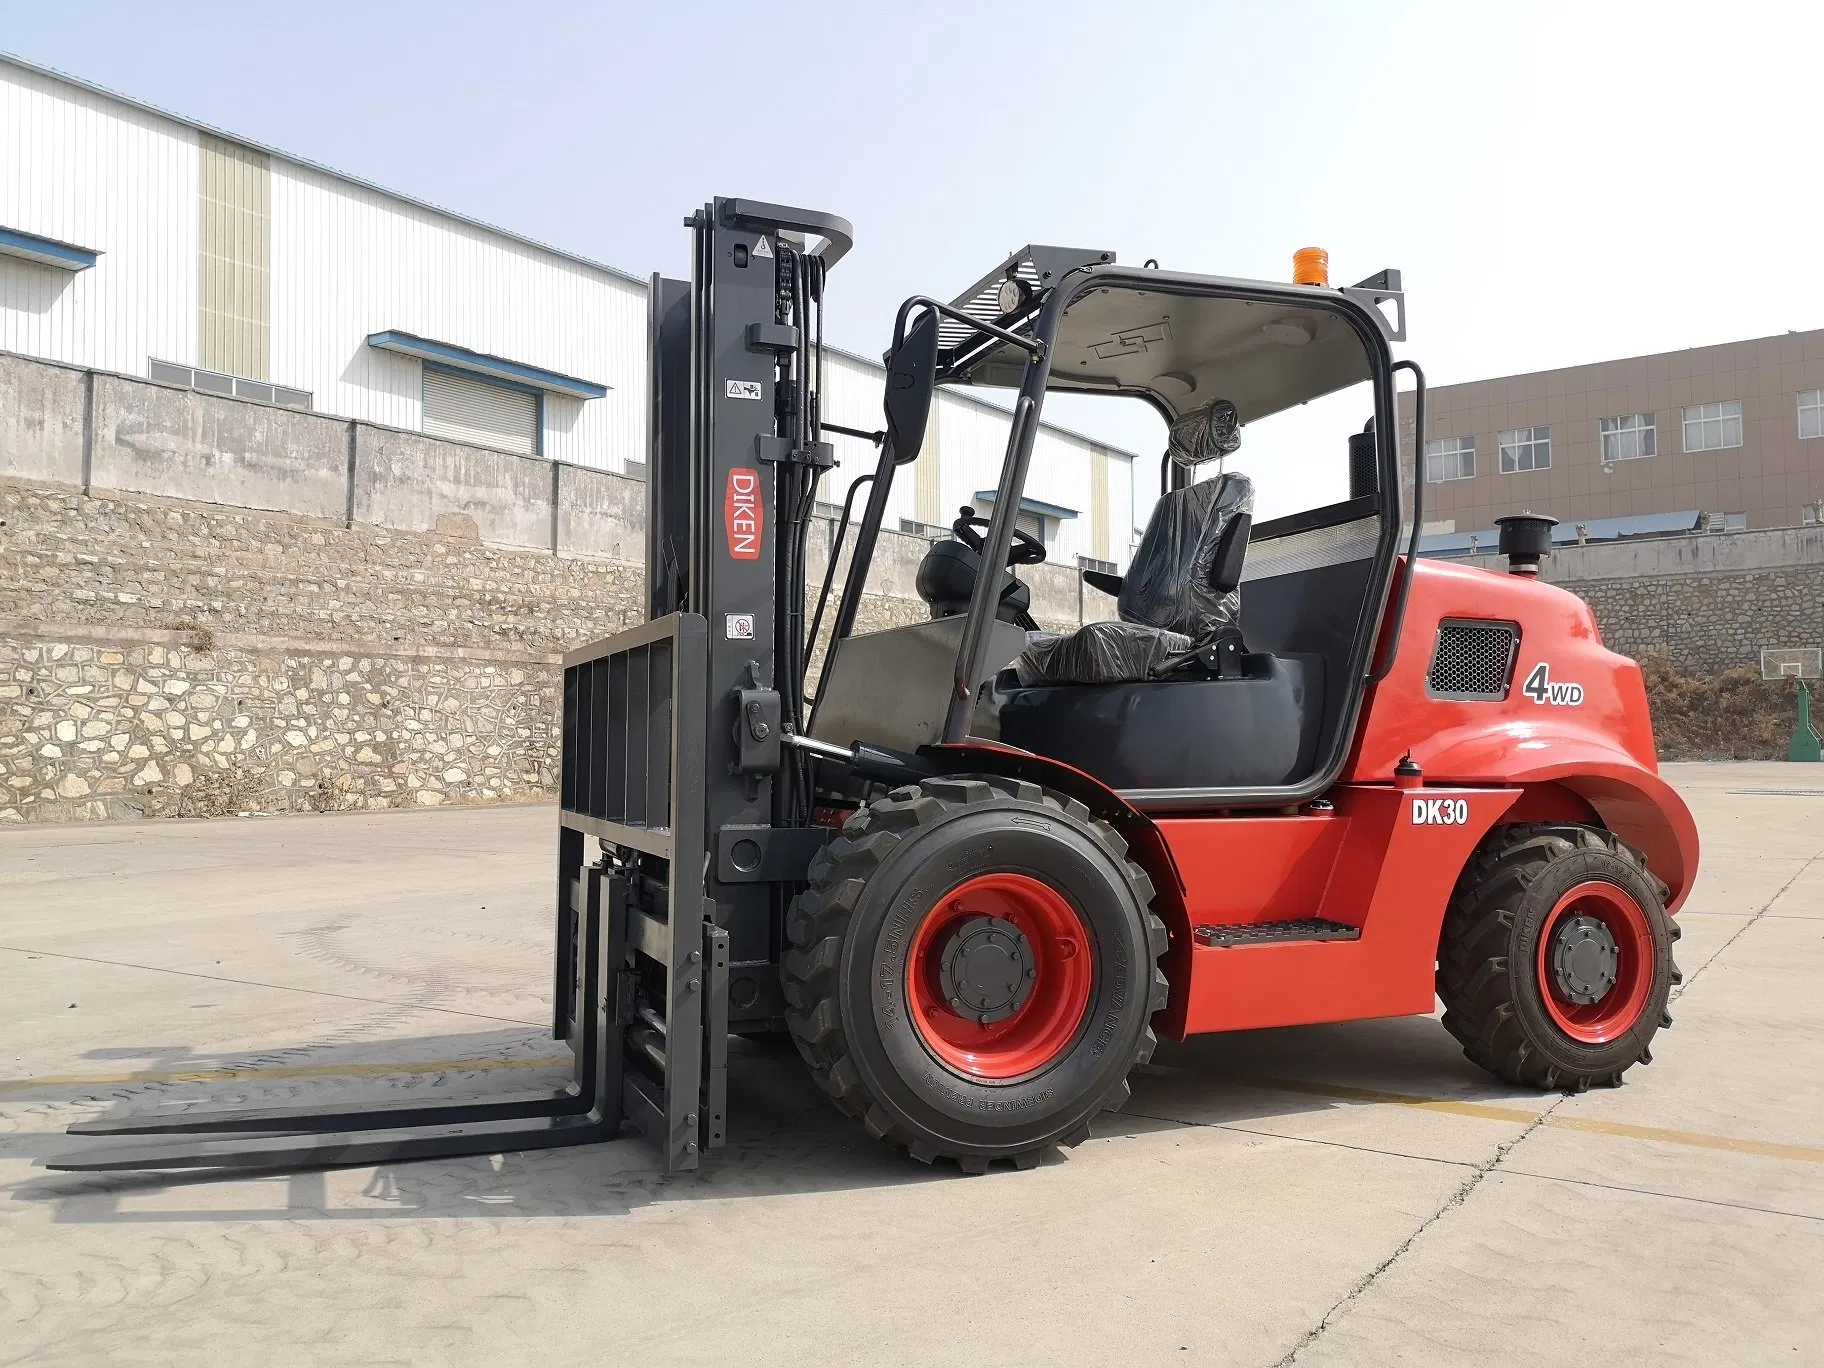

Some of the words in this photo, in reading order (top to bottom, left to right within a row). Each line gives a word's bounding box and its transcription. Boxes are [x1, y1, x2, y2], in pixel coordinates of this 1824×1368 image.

[733, 474, 756, 553] DIKEN
[1523, 662, 1583, 706] 4WD
[1412, 799, 1468, 825] DK30
[979, 1088, 1055, 1112] SIDEWINDER
